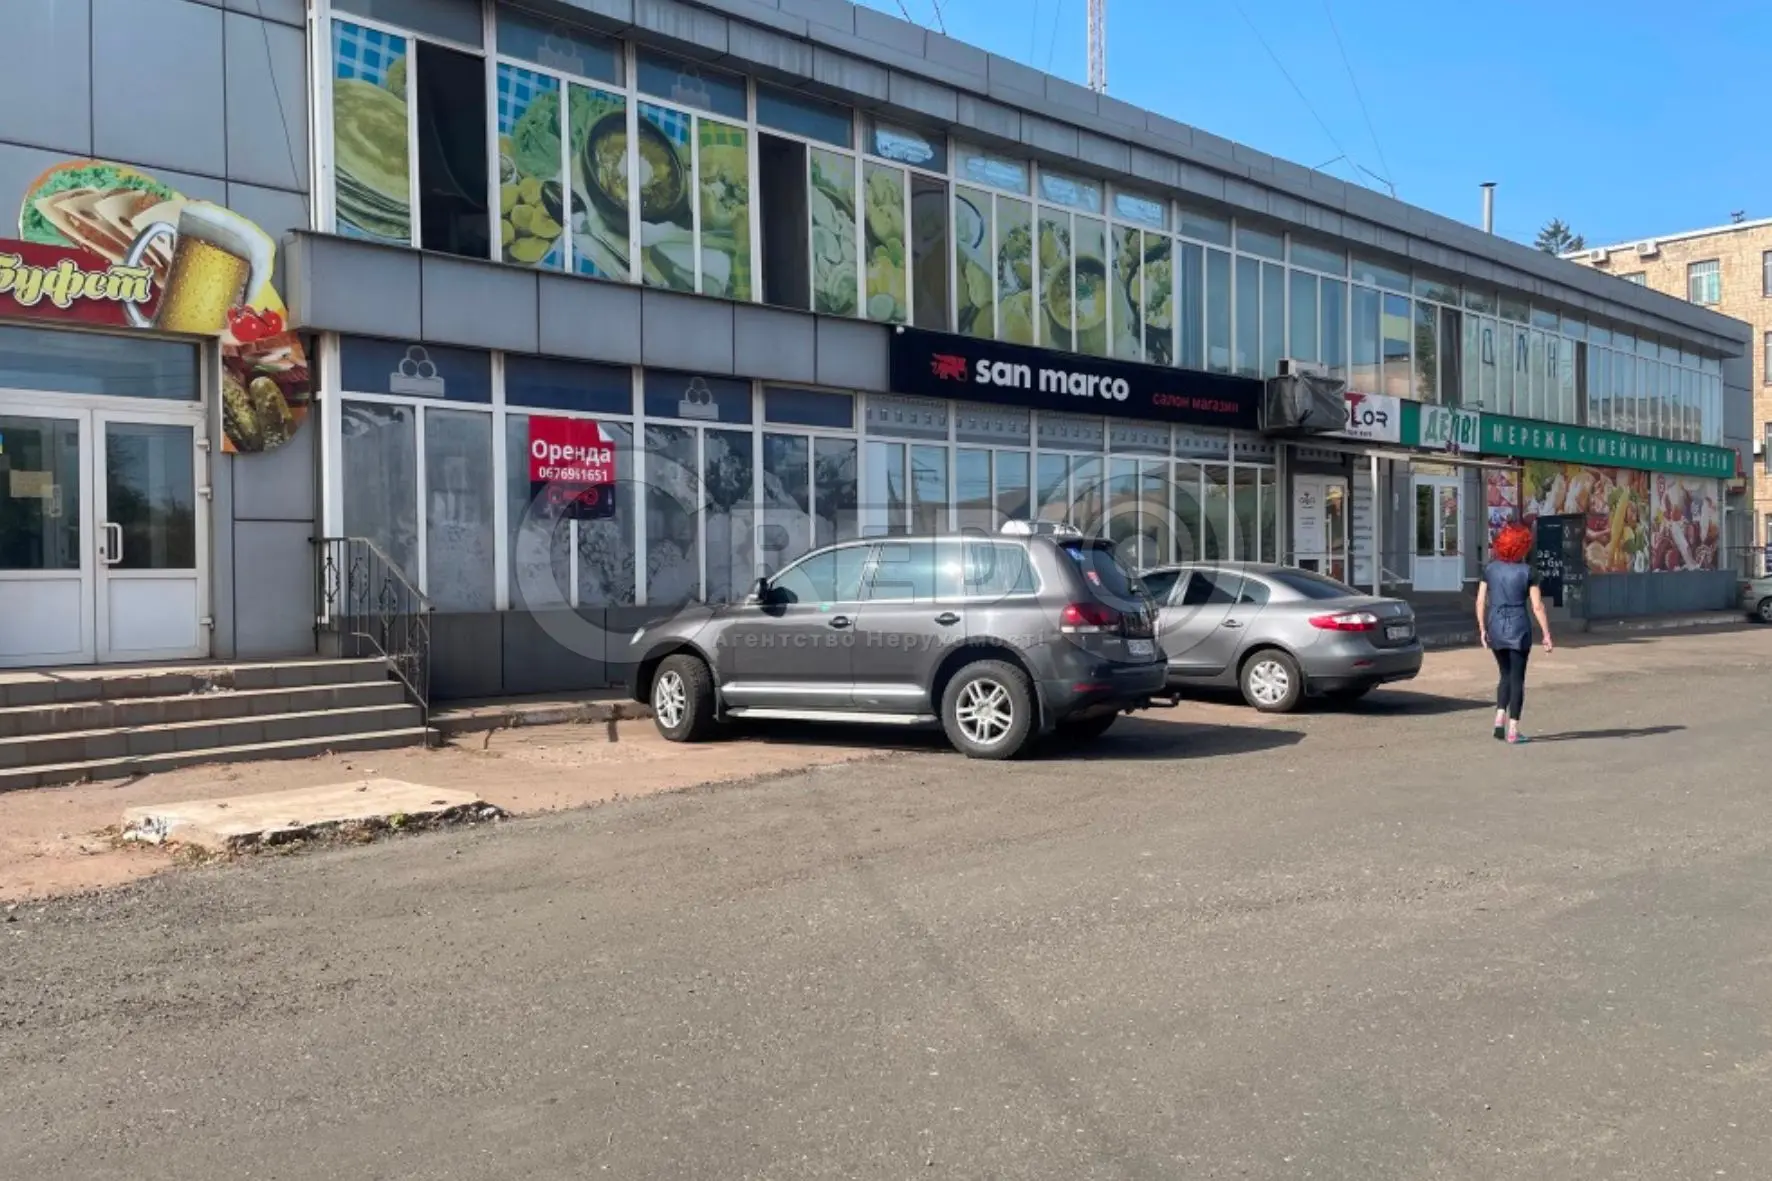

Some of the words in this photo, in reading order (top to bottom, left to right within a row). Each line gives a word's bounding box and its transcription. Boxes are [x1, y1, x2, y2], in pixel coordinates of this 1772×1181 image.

[974, 358, 1031, 388] san
[1038, 368, 1130, 402] marco
[1152, 393, 1188, 407] салон
[1191, 397, 1239, 414] магазин
[531, 438, 611, 466] Оренда
[1493, 423, 1567, 451] МЕРЕЖА
[1578, 434, 1657, 462] СІМЕЙНИХ
[1666, 447, 1728, 471] МАРКЕТІВ
